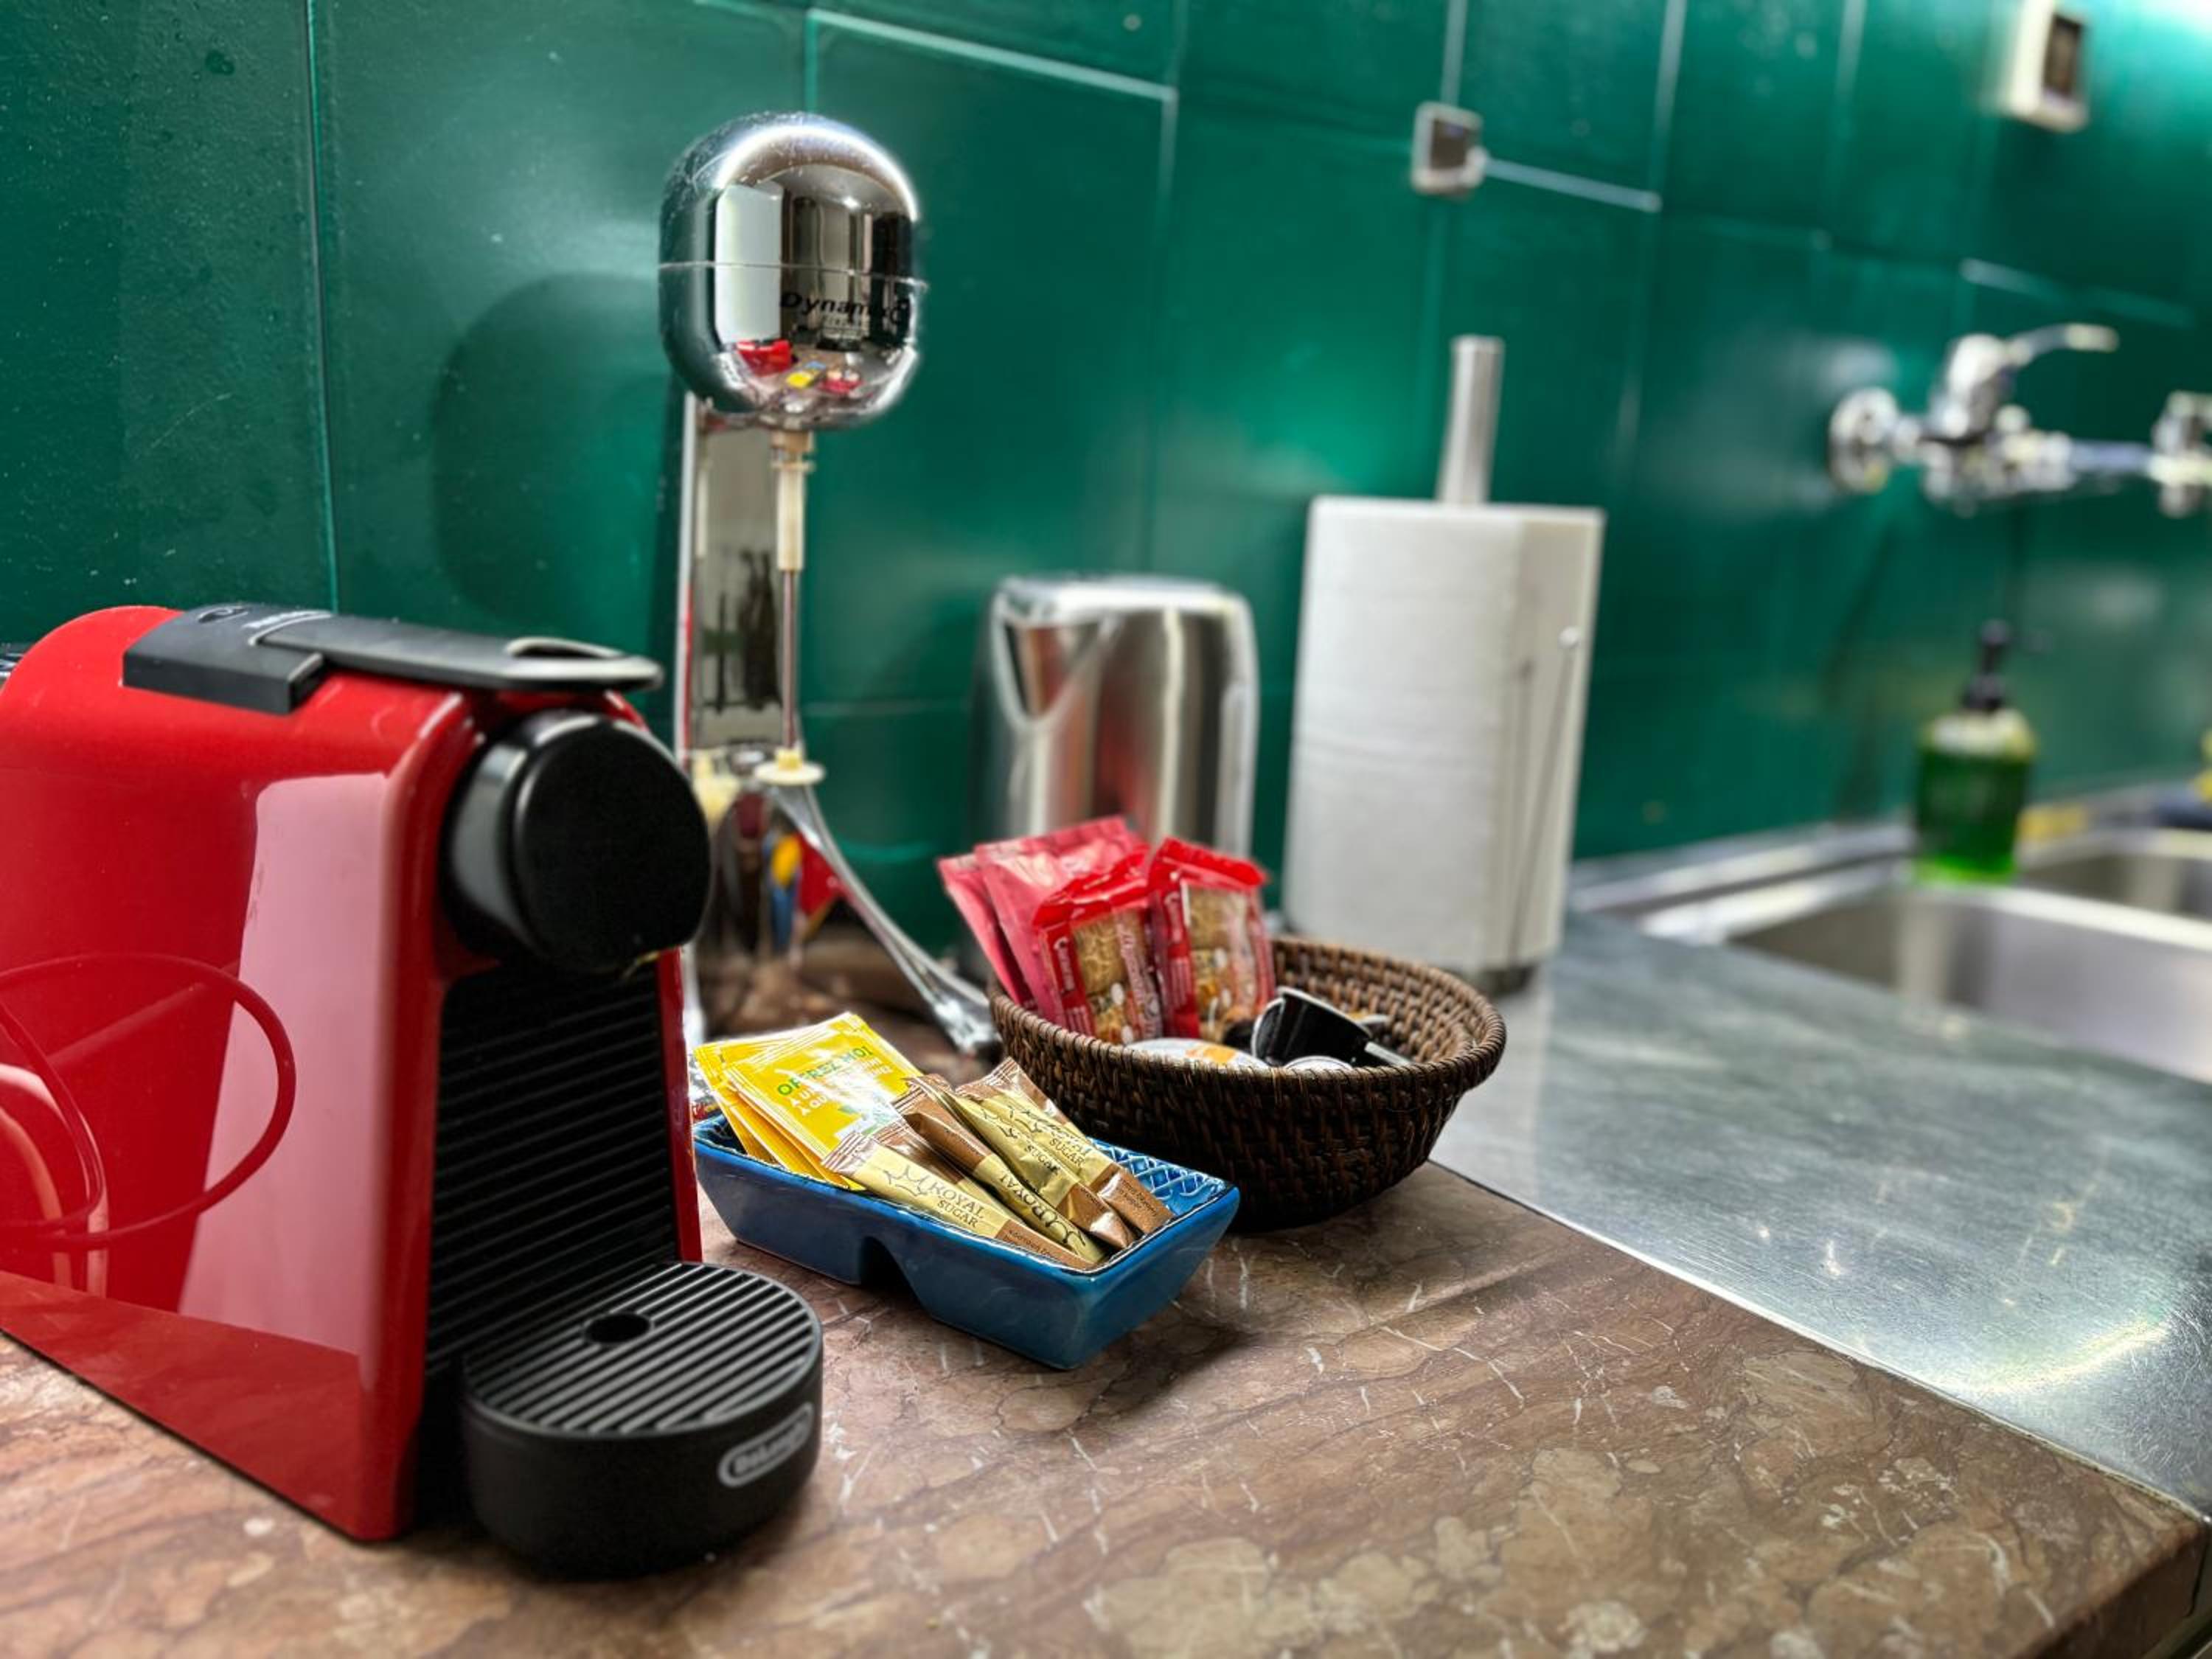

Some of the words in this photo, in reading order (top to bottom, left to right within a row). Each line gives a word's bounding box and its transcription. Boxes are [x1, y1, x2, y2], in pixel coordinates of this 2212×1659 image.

[1024, 1144, 1062, 1176] SUGAR
[1049, 1137, 1085, 1167] SUGAR
[929, 1180, 984, 1219] ROYAL
[937, 1199, 979, 1228] SUGAR
